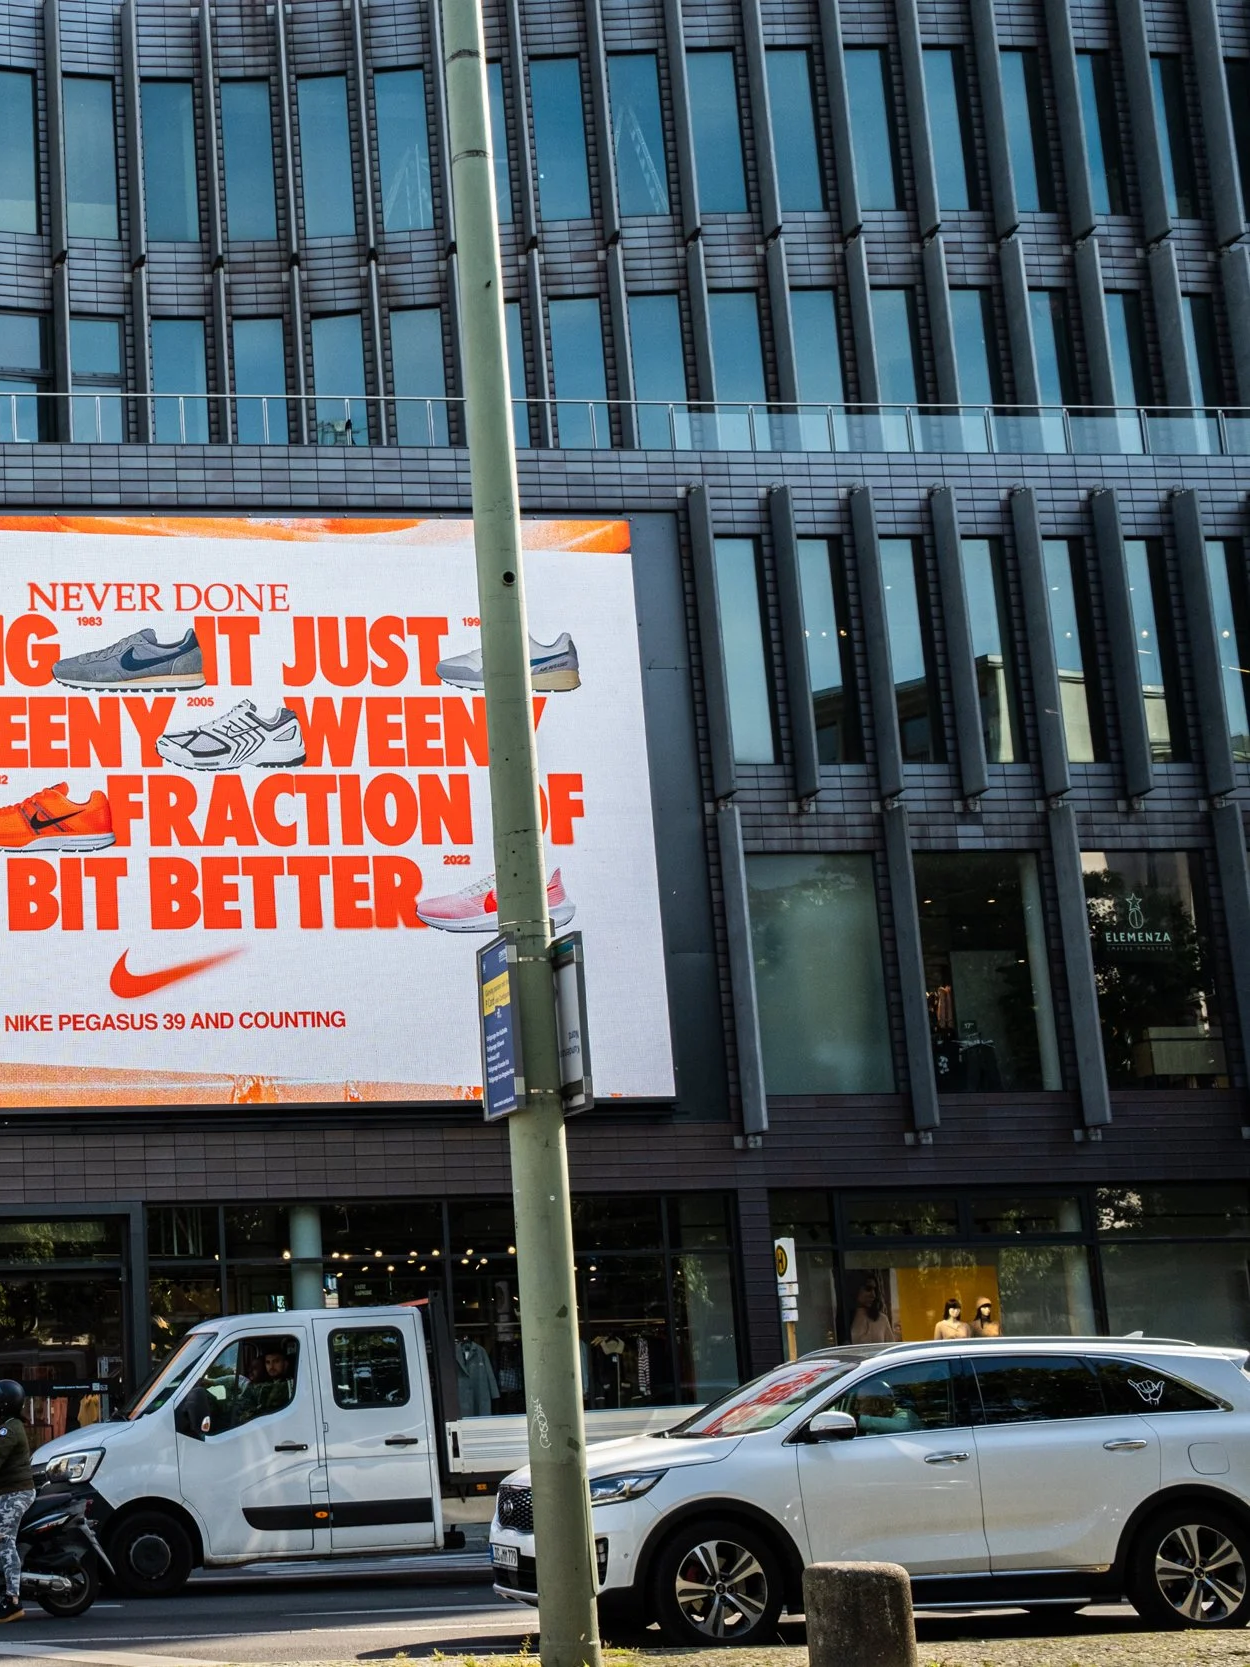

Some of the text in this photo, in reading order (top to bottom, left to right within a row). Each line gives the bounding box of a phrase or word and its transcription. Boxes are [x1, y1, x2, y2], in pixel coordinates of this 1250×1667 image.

[28, 582, 290, 612] NEVER DONE
[77, 616, 103, 627] 1983
[462, 617, 481, 627] 199
[194, 616, 260, 687] IT
[282, 615, 448, 687] JUST
[186, 696, 215, 707] 2005
[107, 773, 474, 848] FRACTION
[538, 773, 585, 846] F
[442, 854, 472, 866] 2022
[7, 857, 128, 931] BIT
[149, 855, 428, 930] BETTER
[1105, 932, 1171, 942] ELEMENZA
[4, 1011, 347, 1031] NIKE PEGASUS 39 AND COUNTING
